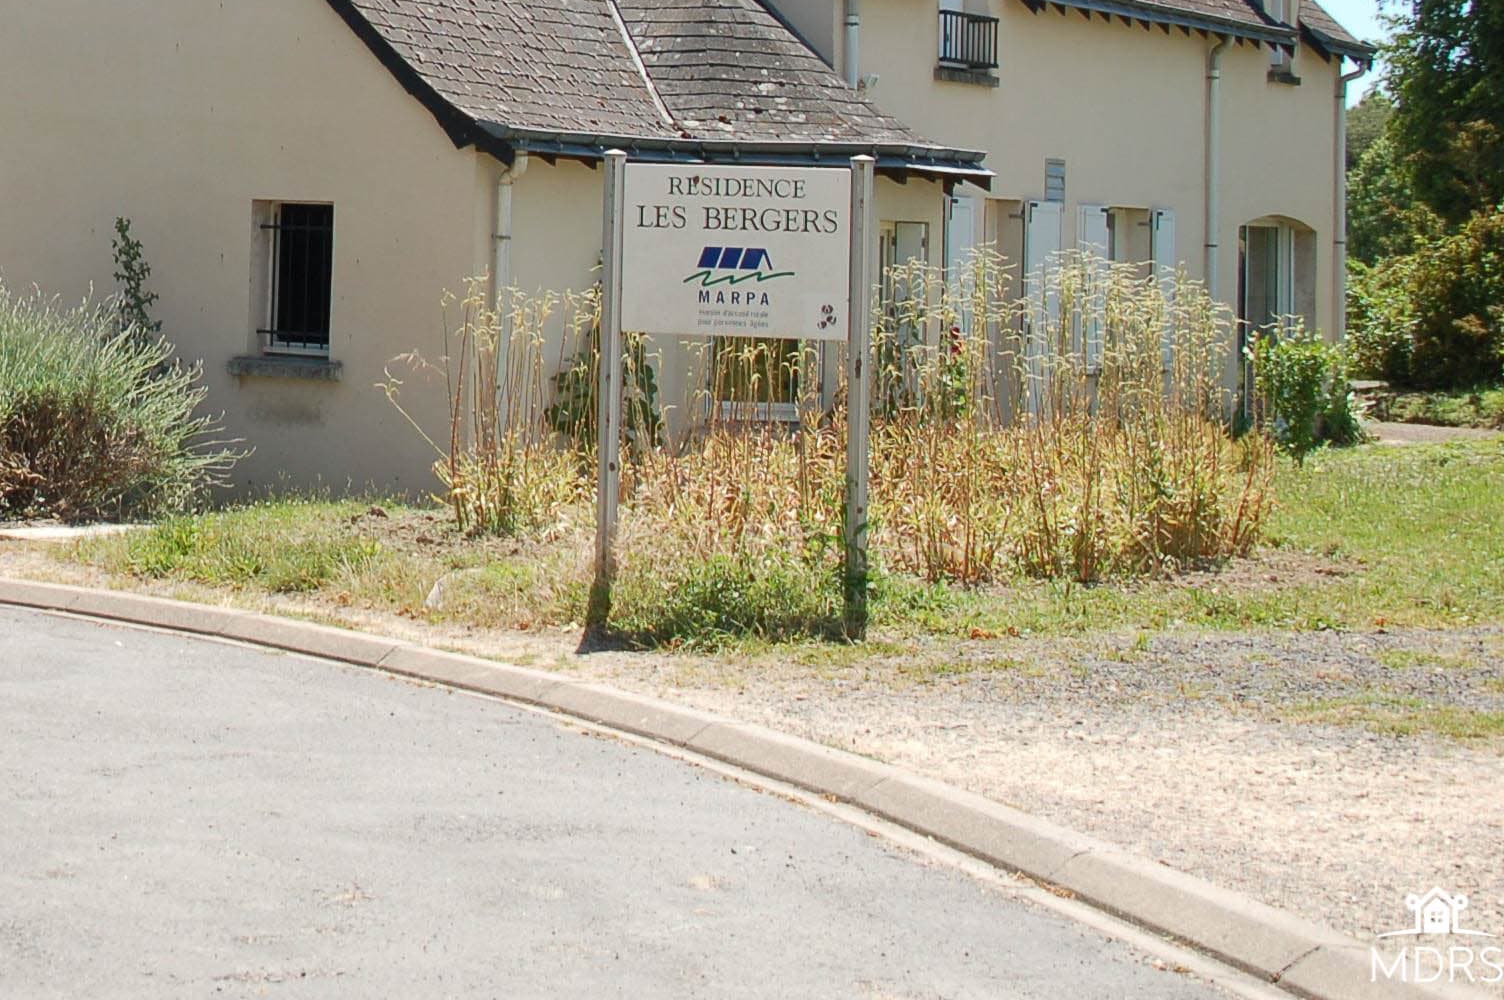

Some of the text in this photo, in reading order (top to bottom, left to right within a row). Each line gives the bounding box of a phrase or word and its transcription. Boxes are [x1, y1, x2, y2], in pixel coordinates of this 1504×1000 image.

[636, 205, 838, 234] LES BERGERS
[698, 290, 769, 306] MARPA
